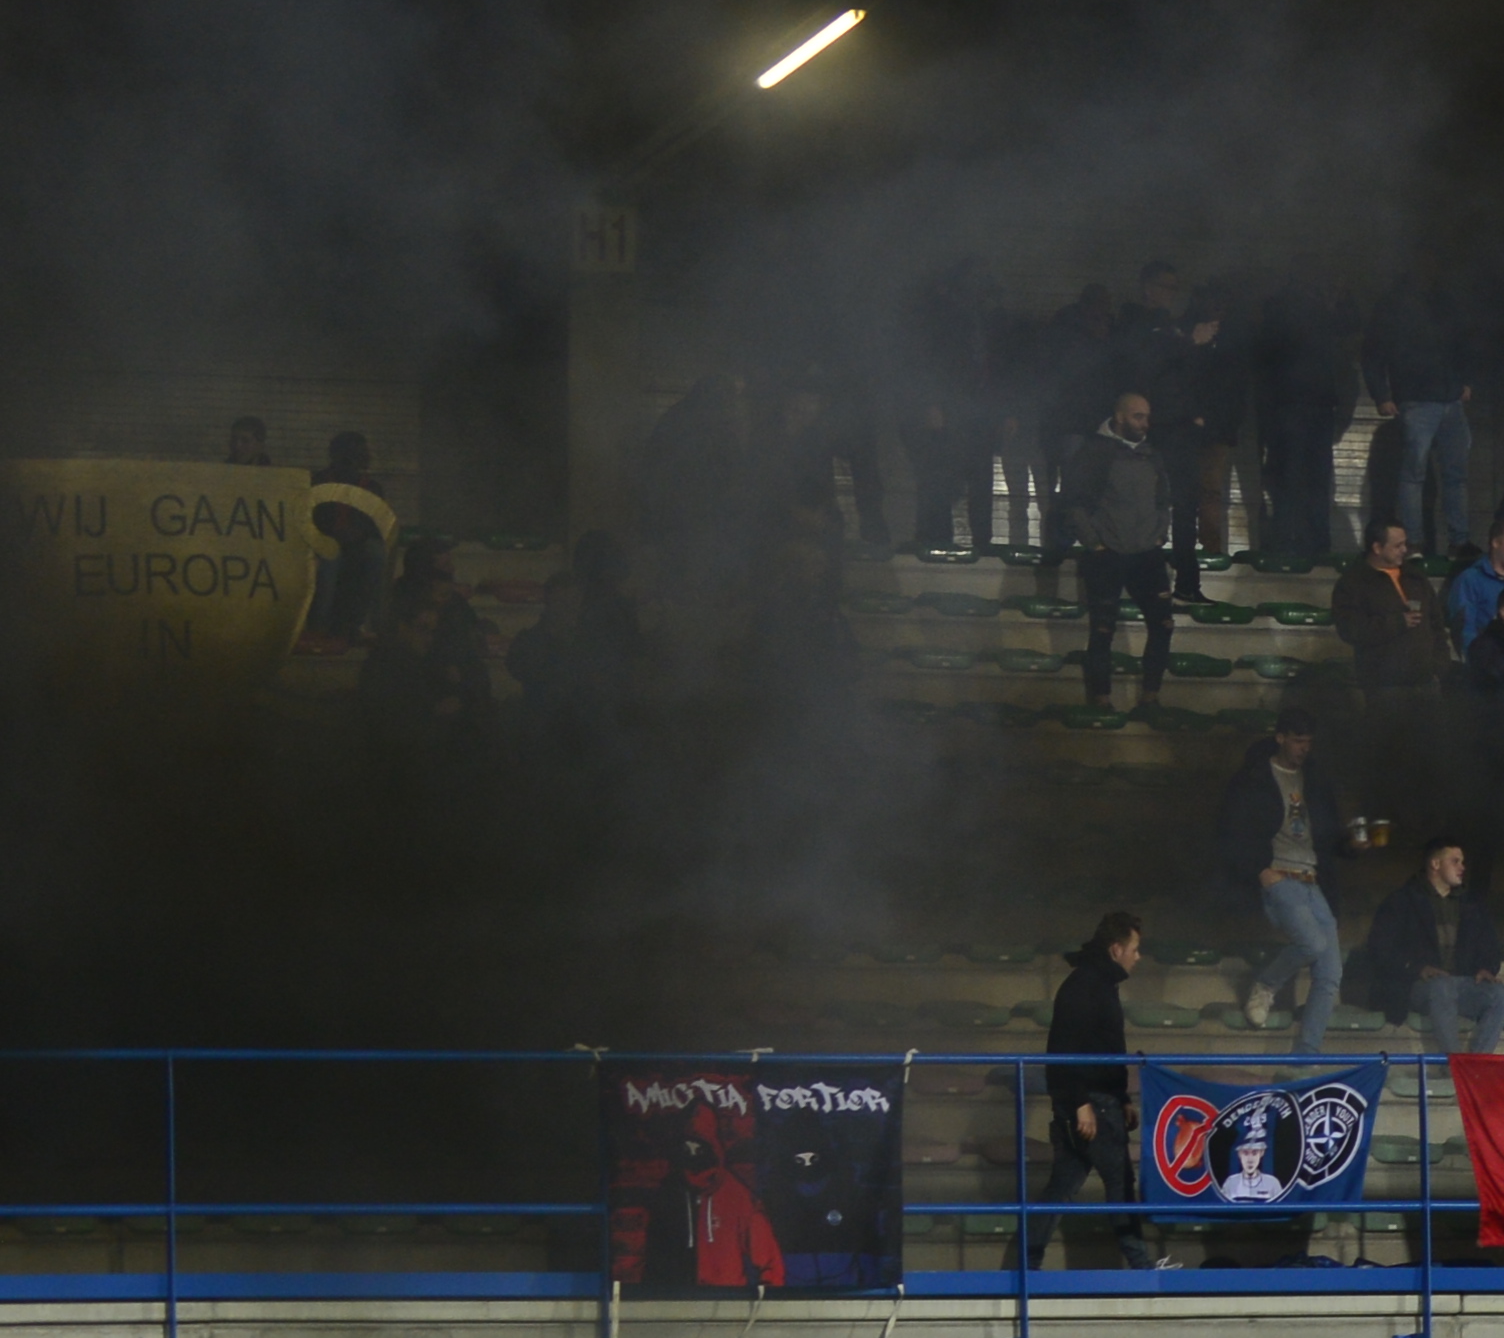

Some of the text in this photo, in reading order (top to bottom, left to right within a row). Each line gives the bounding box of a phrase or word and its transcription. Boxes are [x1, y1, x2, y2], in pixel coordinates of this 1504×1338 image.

[24, 493, 286, 543] WIJ GAAN
[75, 553, 280, 602] EUROPA
[140, 618, 192, 660] IN
[757, 1082, 891, 1114] FORTIOR
